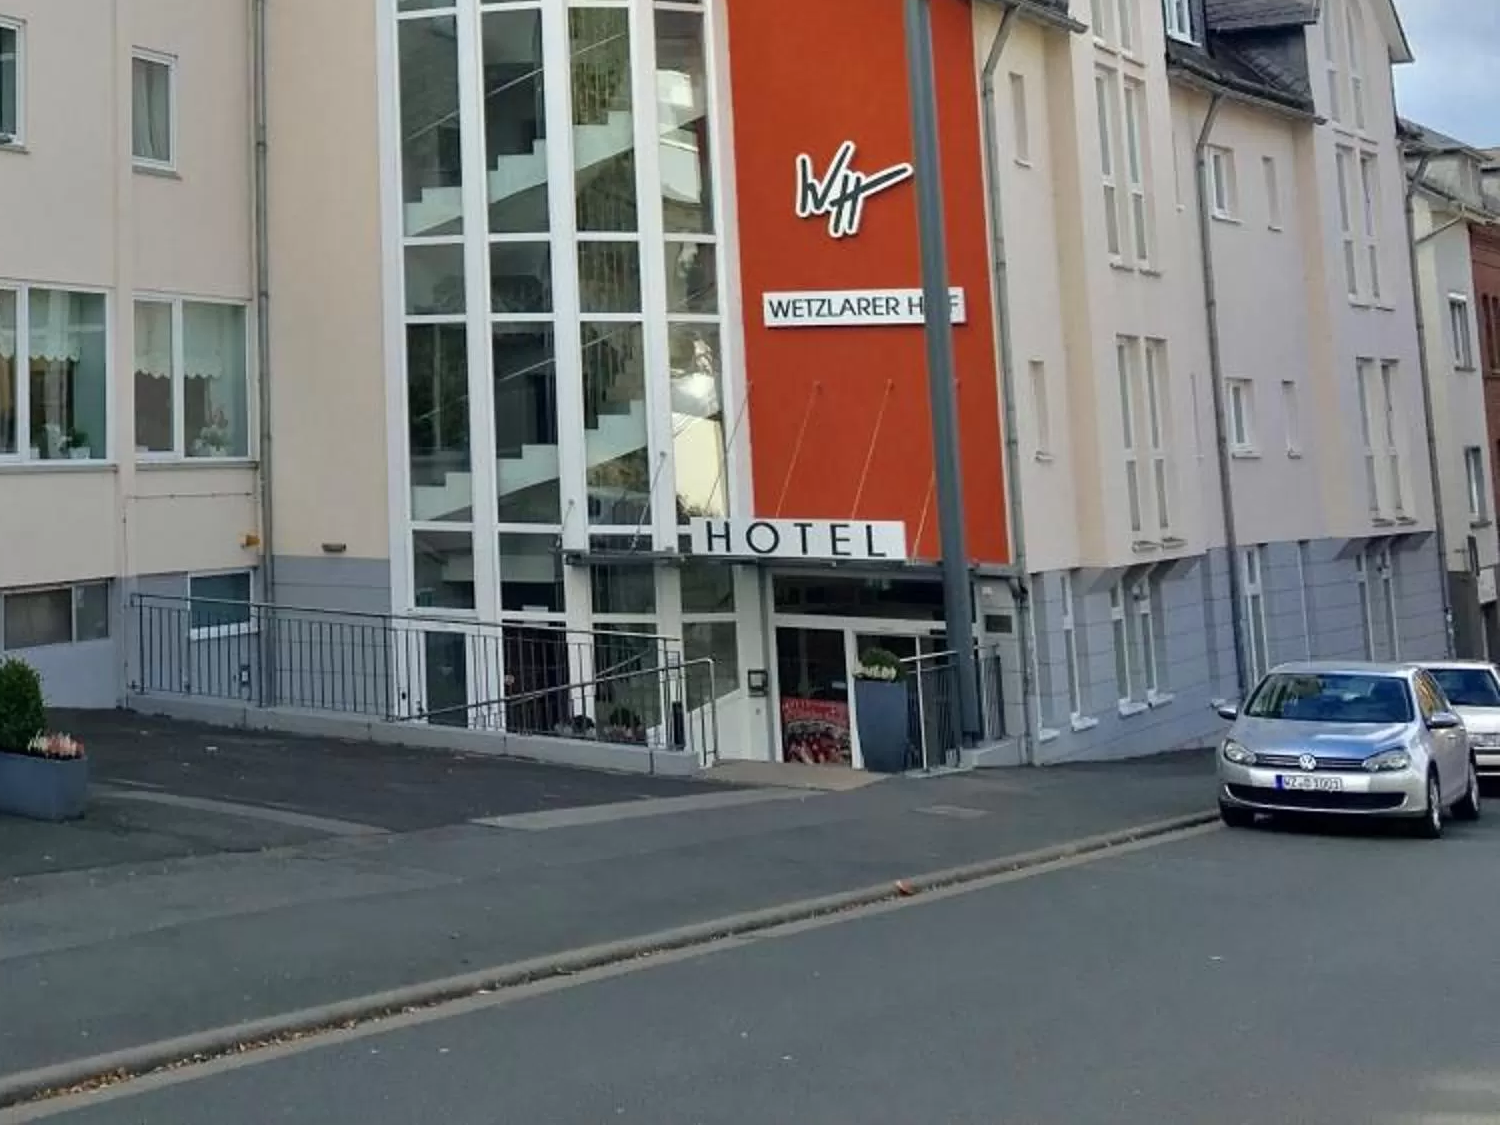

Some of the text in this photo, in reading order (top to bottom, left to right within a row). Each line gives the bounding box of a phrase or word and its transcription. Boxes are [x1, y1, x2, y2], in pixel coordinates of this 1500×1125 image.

[769, 295, 960, 318] WETZLARER HF
[706, 520, 887, 557] HOTEL
